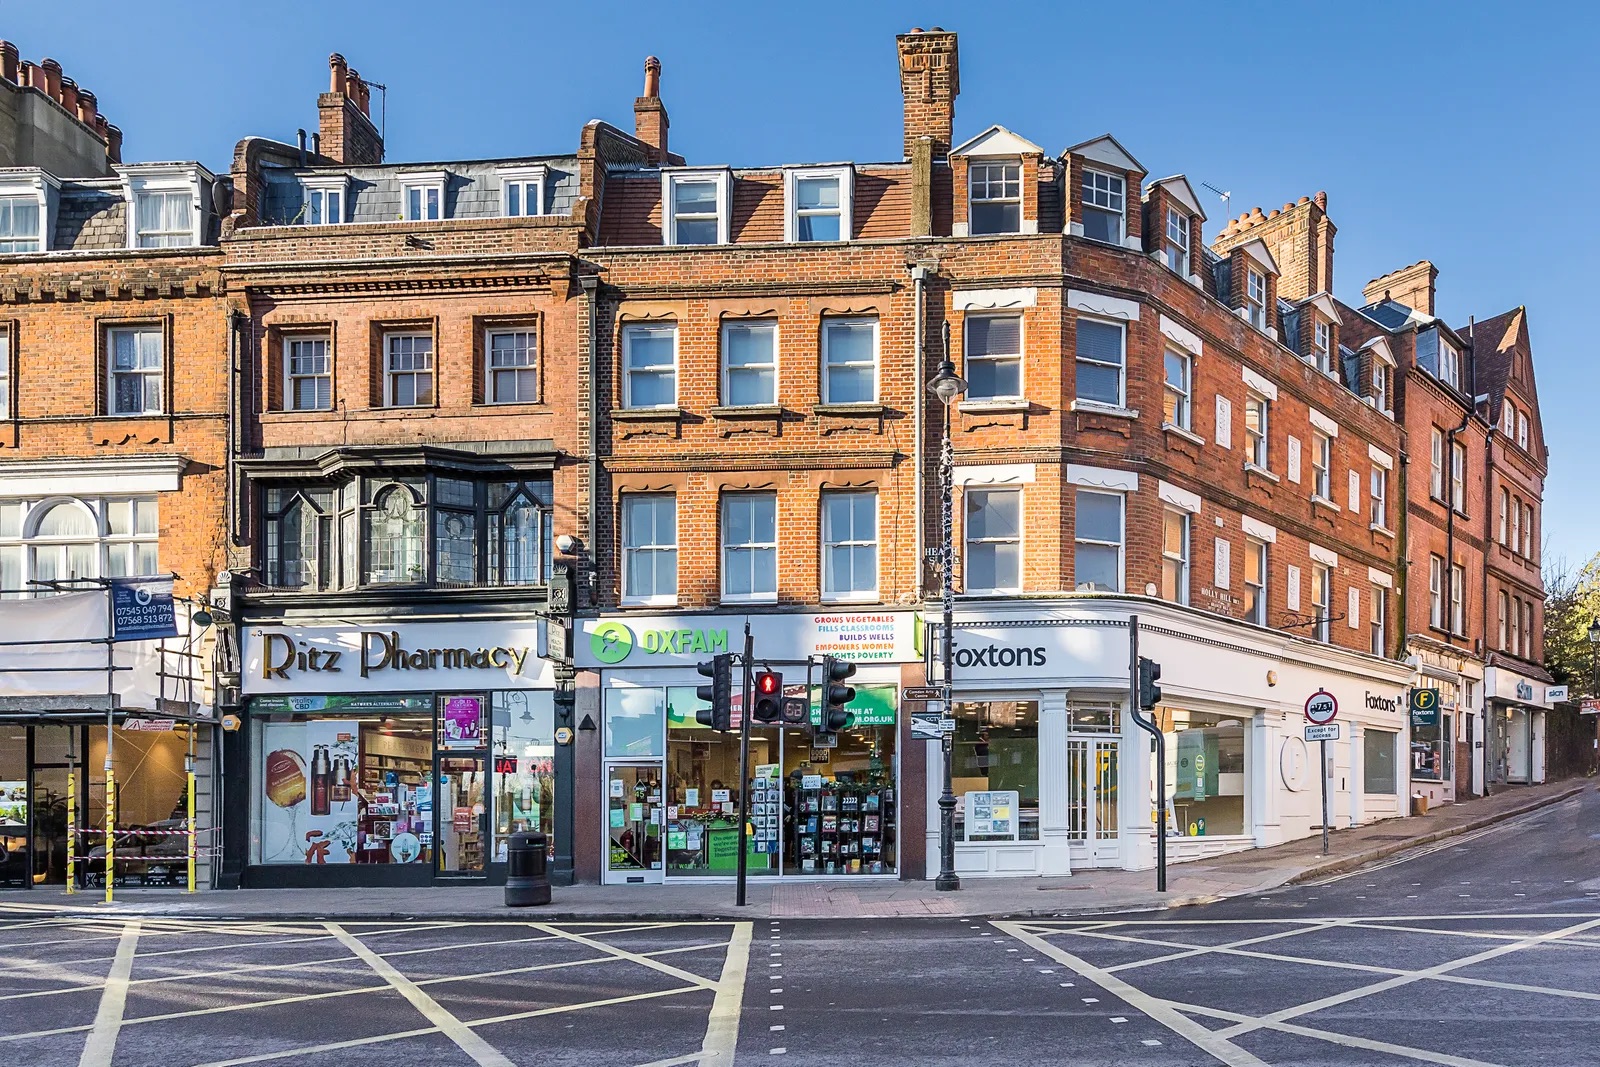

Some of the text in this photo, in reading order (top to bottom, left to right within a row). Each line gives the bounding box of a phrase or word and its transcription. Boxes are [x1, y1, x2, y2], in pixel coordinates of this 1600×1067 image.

[925, 548, 957, 556] HEAH
[116, 604, 172, 616] 07545 049 794
[117, 613, 173, 625] 07568 513 872
[814, 615, 895, 624] GROWS VEGETABLES
[840, 624, 895, 632] CLASSROOMS
[642, 629, 729, 655] OXFAM
[839, 633, 867, 641] BUILDS
[815, 643, 860, 651] EMPOWERS
[262, 630, 530, 680] Ritz Pharmacy
[1365, 690, 1396, 713] Foxtons
